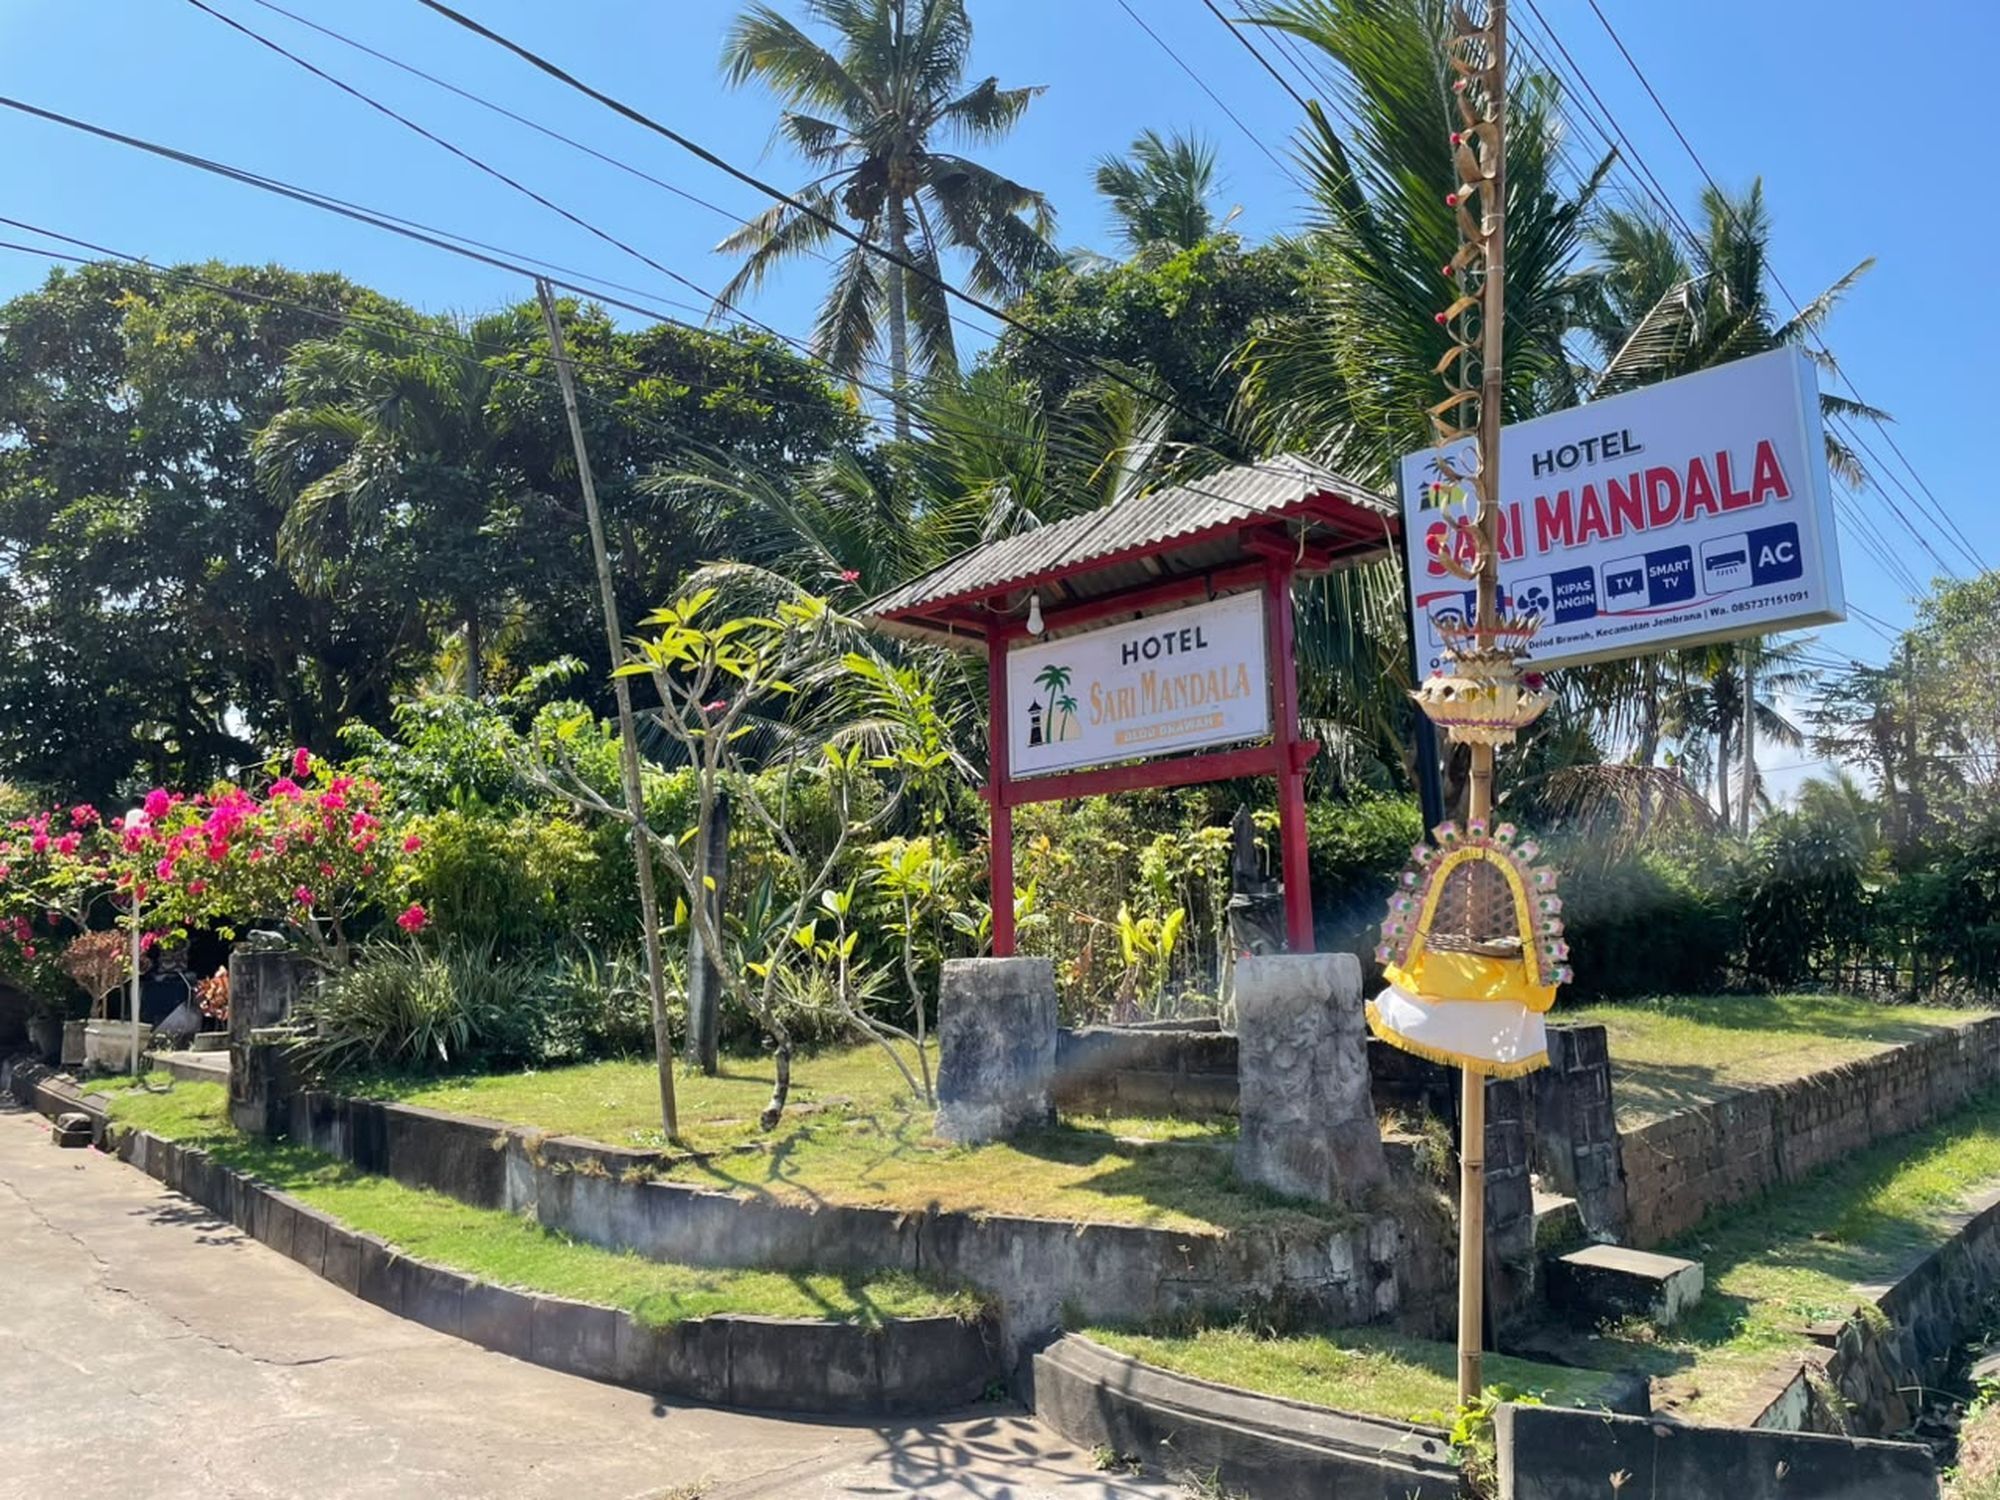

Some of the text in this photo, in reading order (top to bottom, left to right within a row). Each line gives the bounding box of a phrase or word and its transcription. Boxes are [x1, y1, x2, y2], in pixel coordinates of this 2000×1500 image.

[1532, 429, 1641, 476] HOTEL
[1535, 439, 1790, 552] MANDALA
[1758, 541, 1794, 567] AC
[1649, 559, 1690, 577] SMART
[1556, 580, 1592, 596] KIPAS
[1616, 577, 1634, 590] TV
[1662, 577, 1679, 589] TV
[1556, 592, 1595, 611] ANGIN
[1596, 617, 1650, 638] Kecamatan
[1652, 612, 1702, 628] Jembrana
[1710, 606, 1729, 617] Wa.
[1731, 591, 1809, 613] 085737151091
[1122, 626, 1208, 665] HOTEL
[1089, 661, 1251, 726] SARI MANDALA
